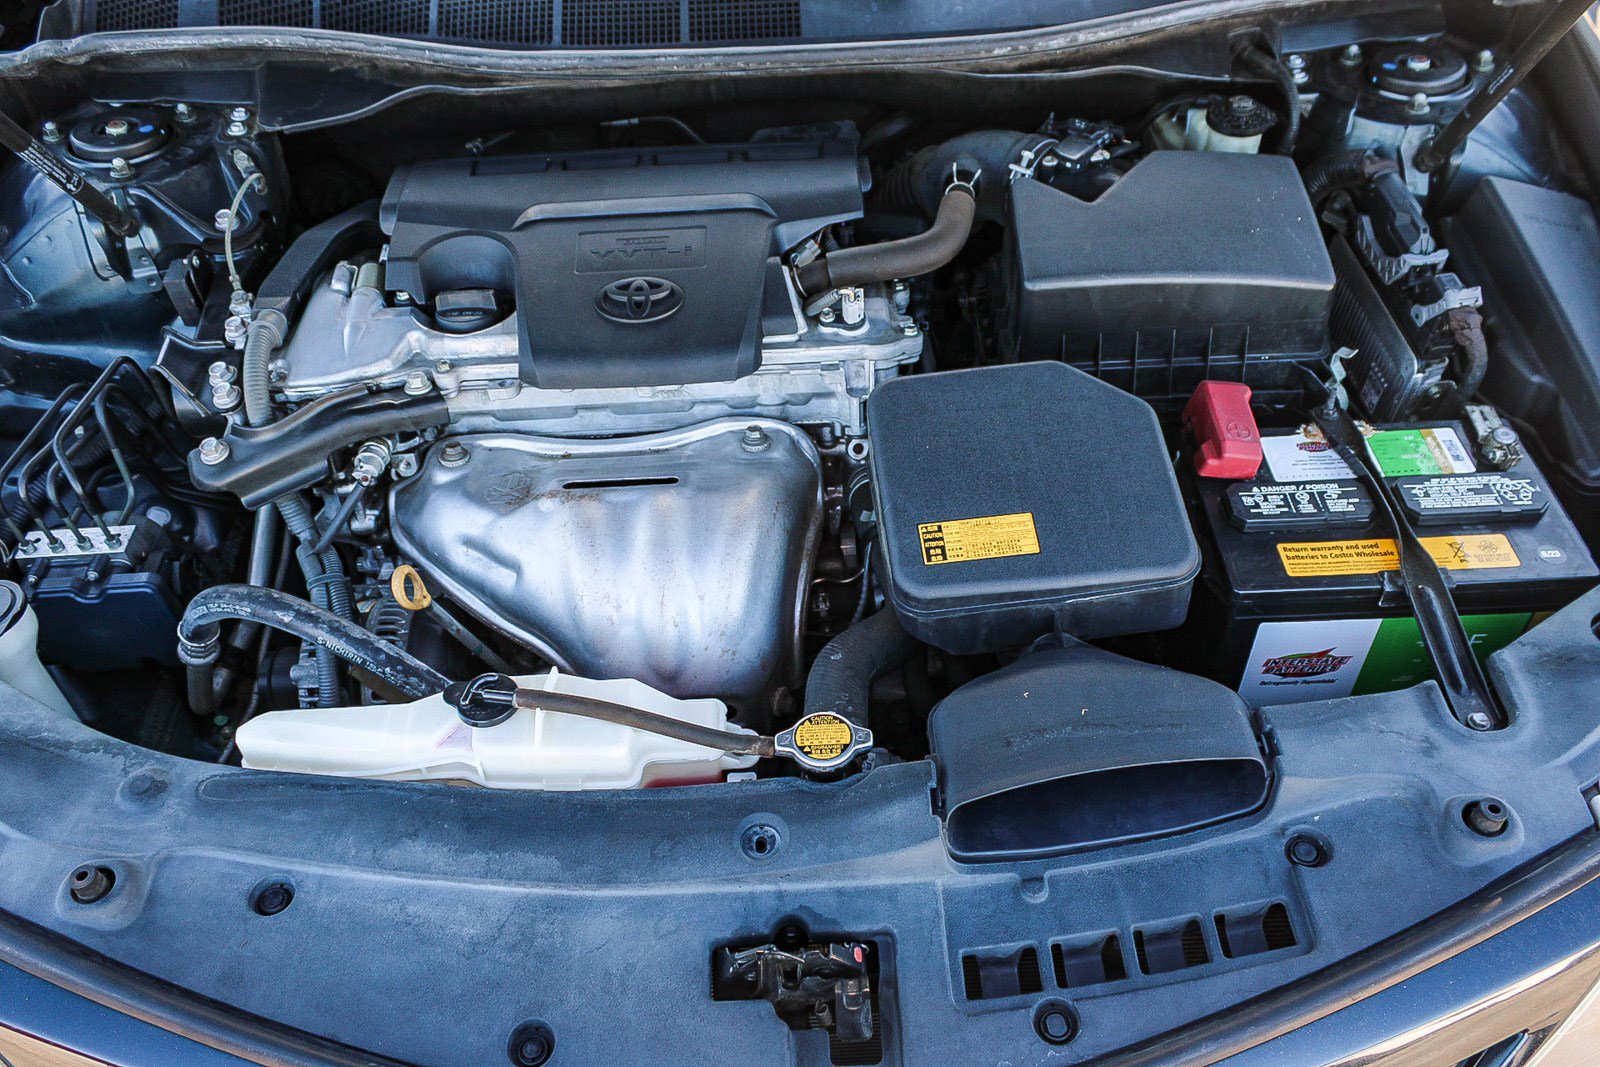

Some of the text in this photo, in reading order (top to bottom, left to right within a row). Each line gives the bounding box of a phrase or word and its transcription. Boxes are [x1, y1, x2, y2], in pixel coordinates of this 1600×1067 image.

[1285, 553, 1320, 561] batteries
[1355, 550, 1395, 558] Wholesale
[316, 636, 363, 664] S-NICHIRIN
[1262, 656, 1353, 667] INTERSTATE
